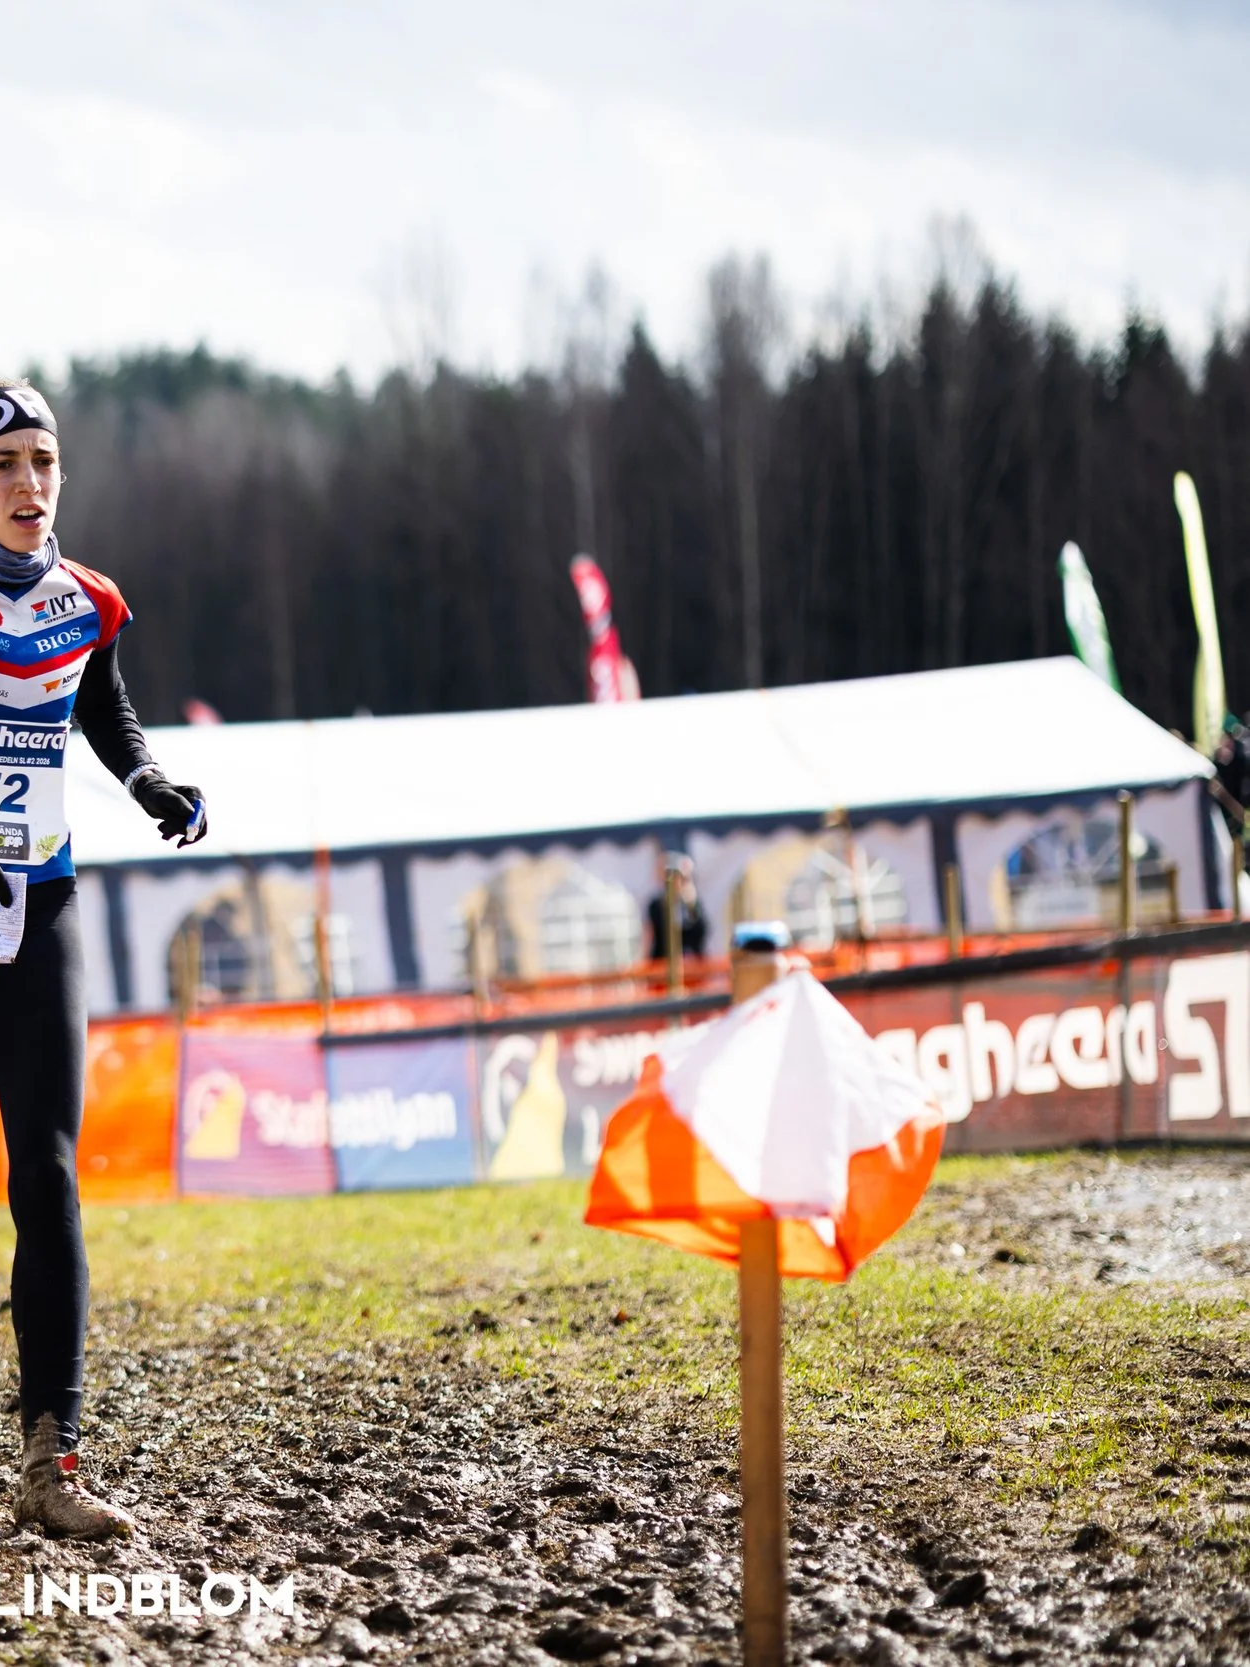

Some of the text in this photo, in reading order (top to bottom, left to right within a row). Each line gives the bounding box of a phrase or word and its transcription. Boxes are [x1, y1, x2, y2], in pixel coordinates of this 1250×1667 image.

[49, 592, 77, 616] IVT
[35, 627, 82, 653] BIOS
[873, 1001, 1158, 1123] gheera
